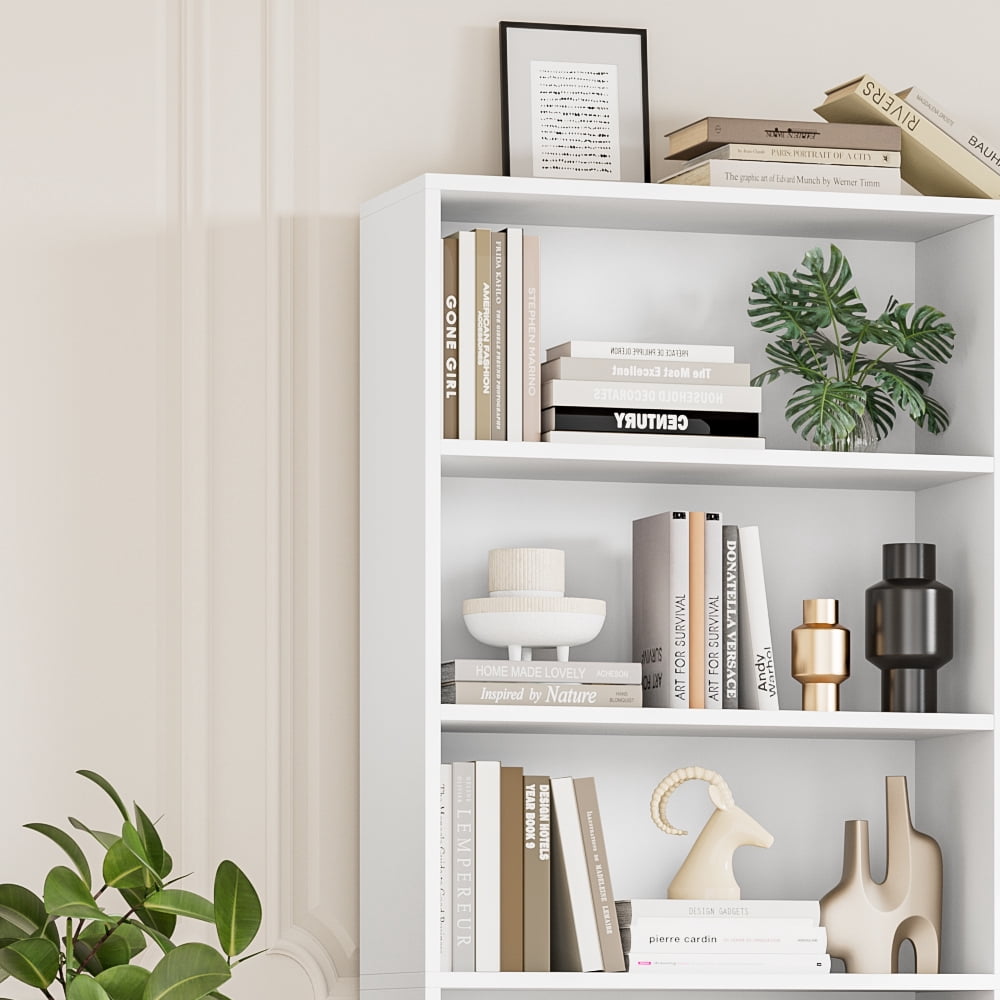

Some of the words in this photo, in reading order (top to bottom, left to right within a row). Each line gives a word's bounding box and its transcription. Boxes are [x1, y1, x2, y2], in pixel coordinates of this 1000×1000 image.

[862, 82, 920, 131] RIVERS
[793, 150, 829, 159] PORTRAIT
[853, 152, 871, 161] CITY
[725, 172, 738, 181] The
[740, 173, 759, 183] graphic
[769, 174, 775, 182] of
[776, 174, 796, 183] Edvard
[797, 176, 821, 185] Munch
[823, 175, 831, 187] by
[833, 177, 857, 186] Werner
[860, 178, 880, 187] Timm
[446, 295, 456, 349] GONE
[528, 288, 536, 344] STEPHEN
[446, 358, 456, 398] GIRL
[528, 347, 536, 396] MARINO
[727, 540, 737, 627] DONATELLA
[675, 594, 686, 646] SURVIVAL
[708, 595, 719, 647] SURVIVAL
[476, 665, 508, 677] HOME
[511, 666, 542, 678] MADE
[545, 667, 586, 679] LOVELY
[675, 650, 686, 674] FOR
[708, 652, 719, 675] FOR
[726, 631, 737, 698] VERSACE
[755, 654, 767, 692] Andy
[480, 687, 523, 701] Inspired
[529, 689, 542, 701] by
[546, 686, 597, 703] Nature
[675, 679, 686, 701] ART
[708, 680, 719, 701] ART
[525, 784, 535, 809] YEAR
[539, 784, 550, 821] DESIGN
[525, 813, 535, 840] BOOK
[539, 824, 550, 860] HOTELS
[457, 809, 471, 947] LEMPEREUR
[689, 907, 715, 915] DESIGN
[649, 935, 680, 944] pierre
[684, 935, 717, 943] cardin
